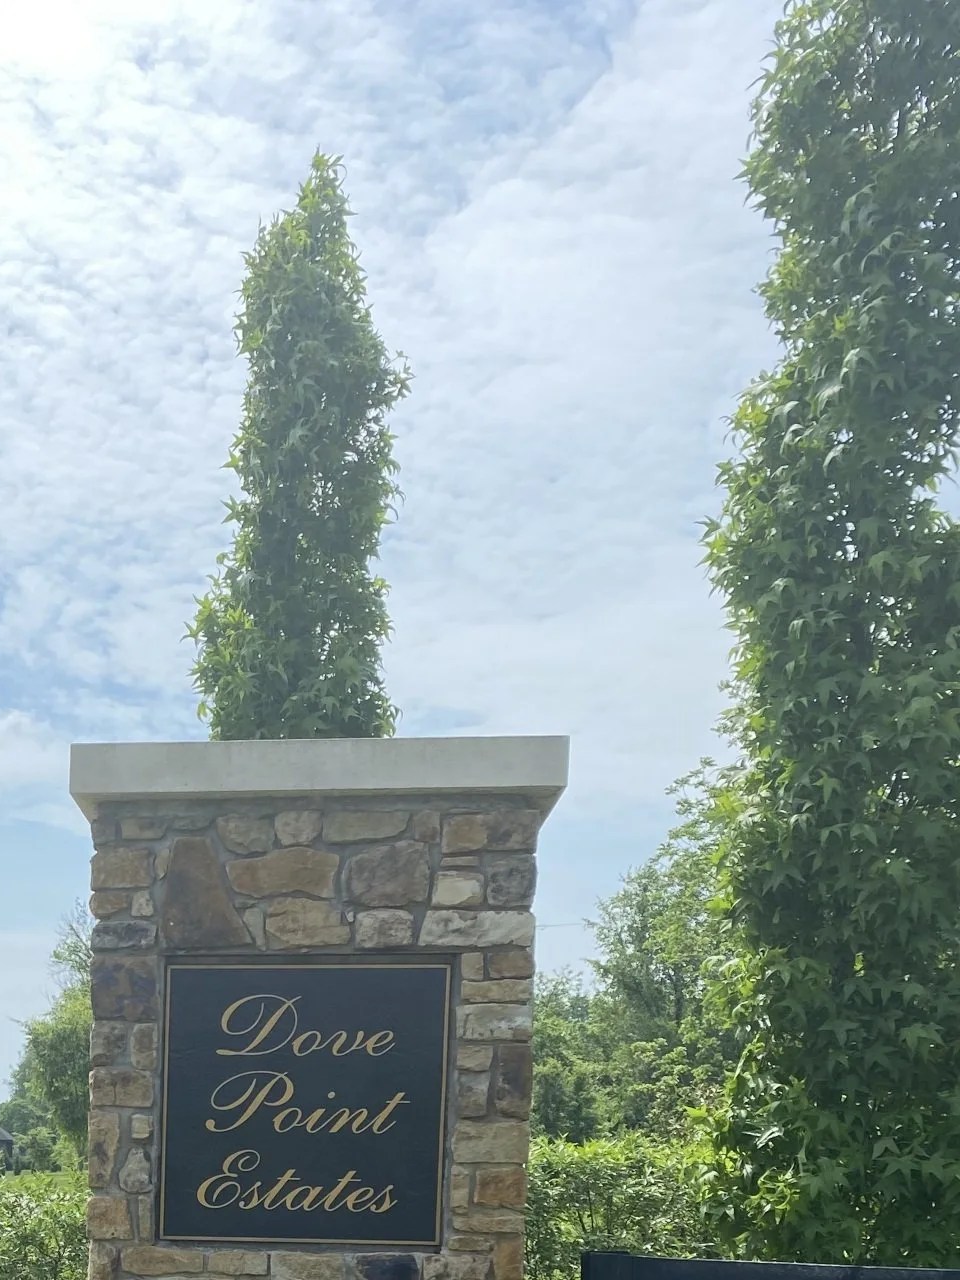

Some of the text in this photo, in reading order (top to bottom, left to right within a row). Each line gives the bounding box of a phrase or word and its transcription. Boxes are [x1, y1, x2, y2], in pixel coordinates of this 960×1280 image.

[215, 993, 396, 1057] Dove
[205, 1070, 411, 1134] Point
[196, 1149, 398, 1213] Estates
